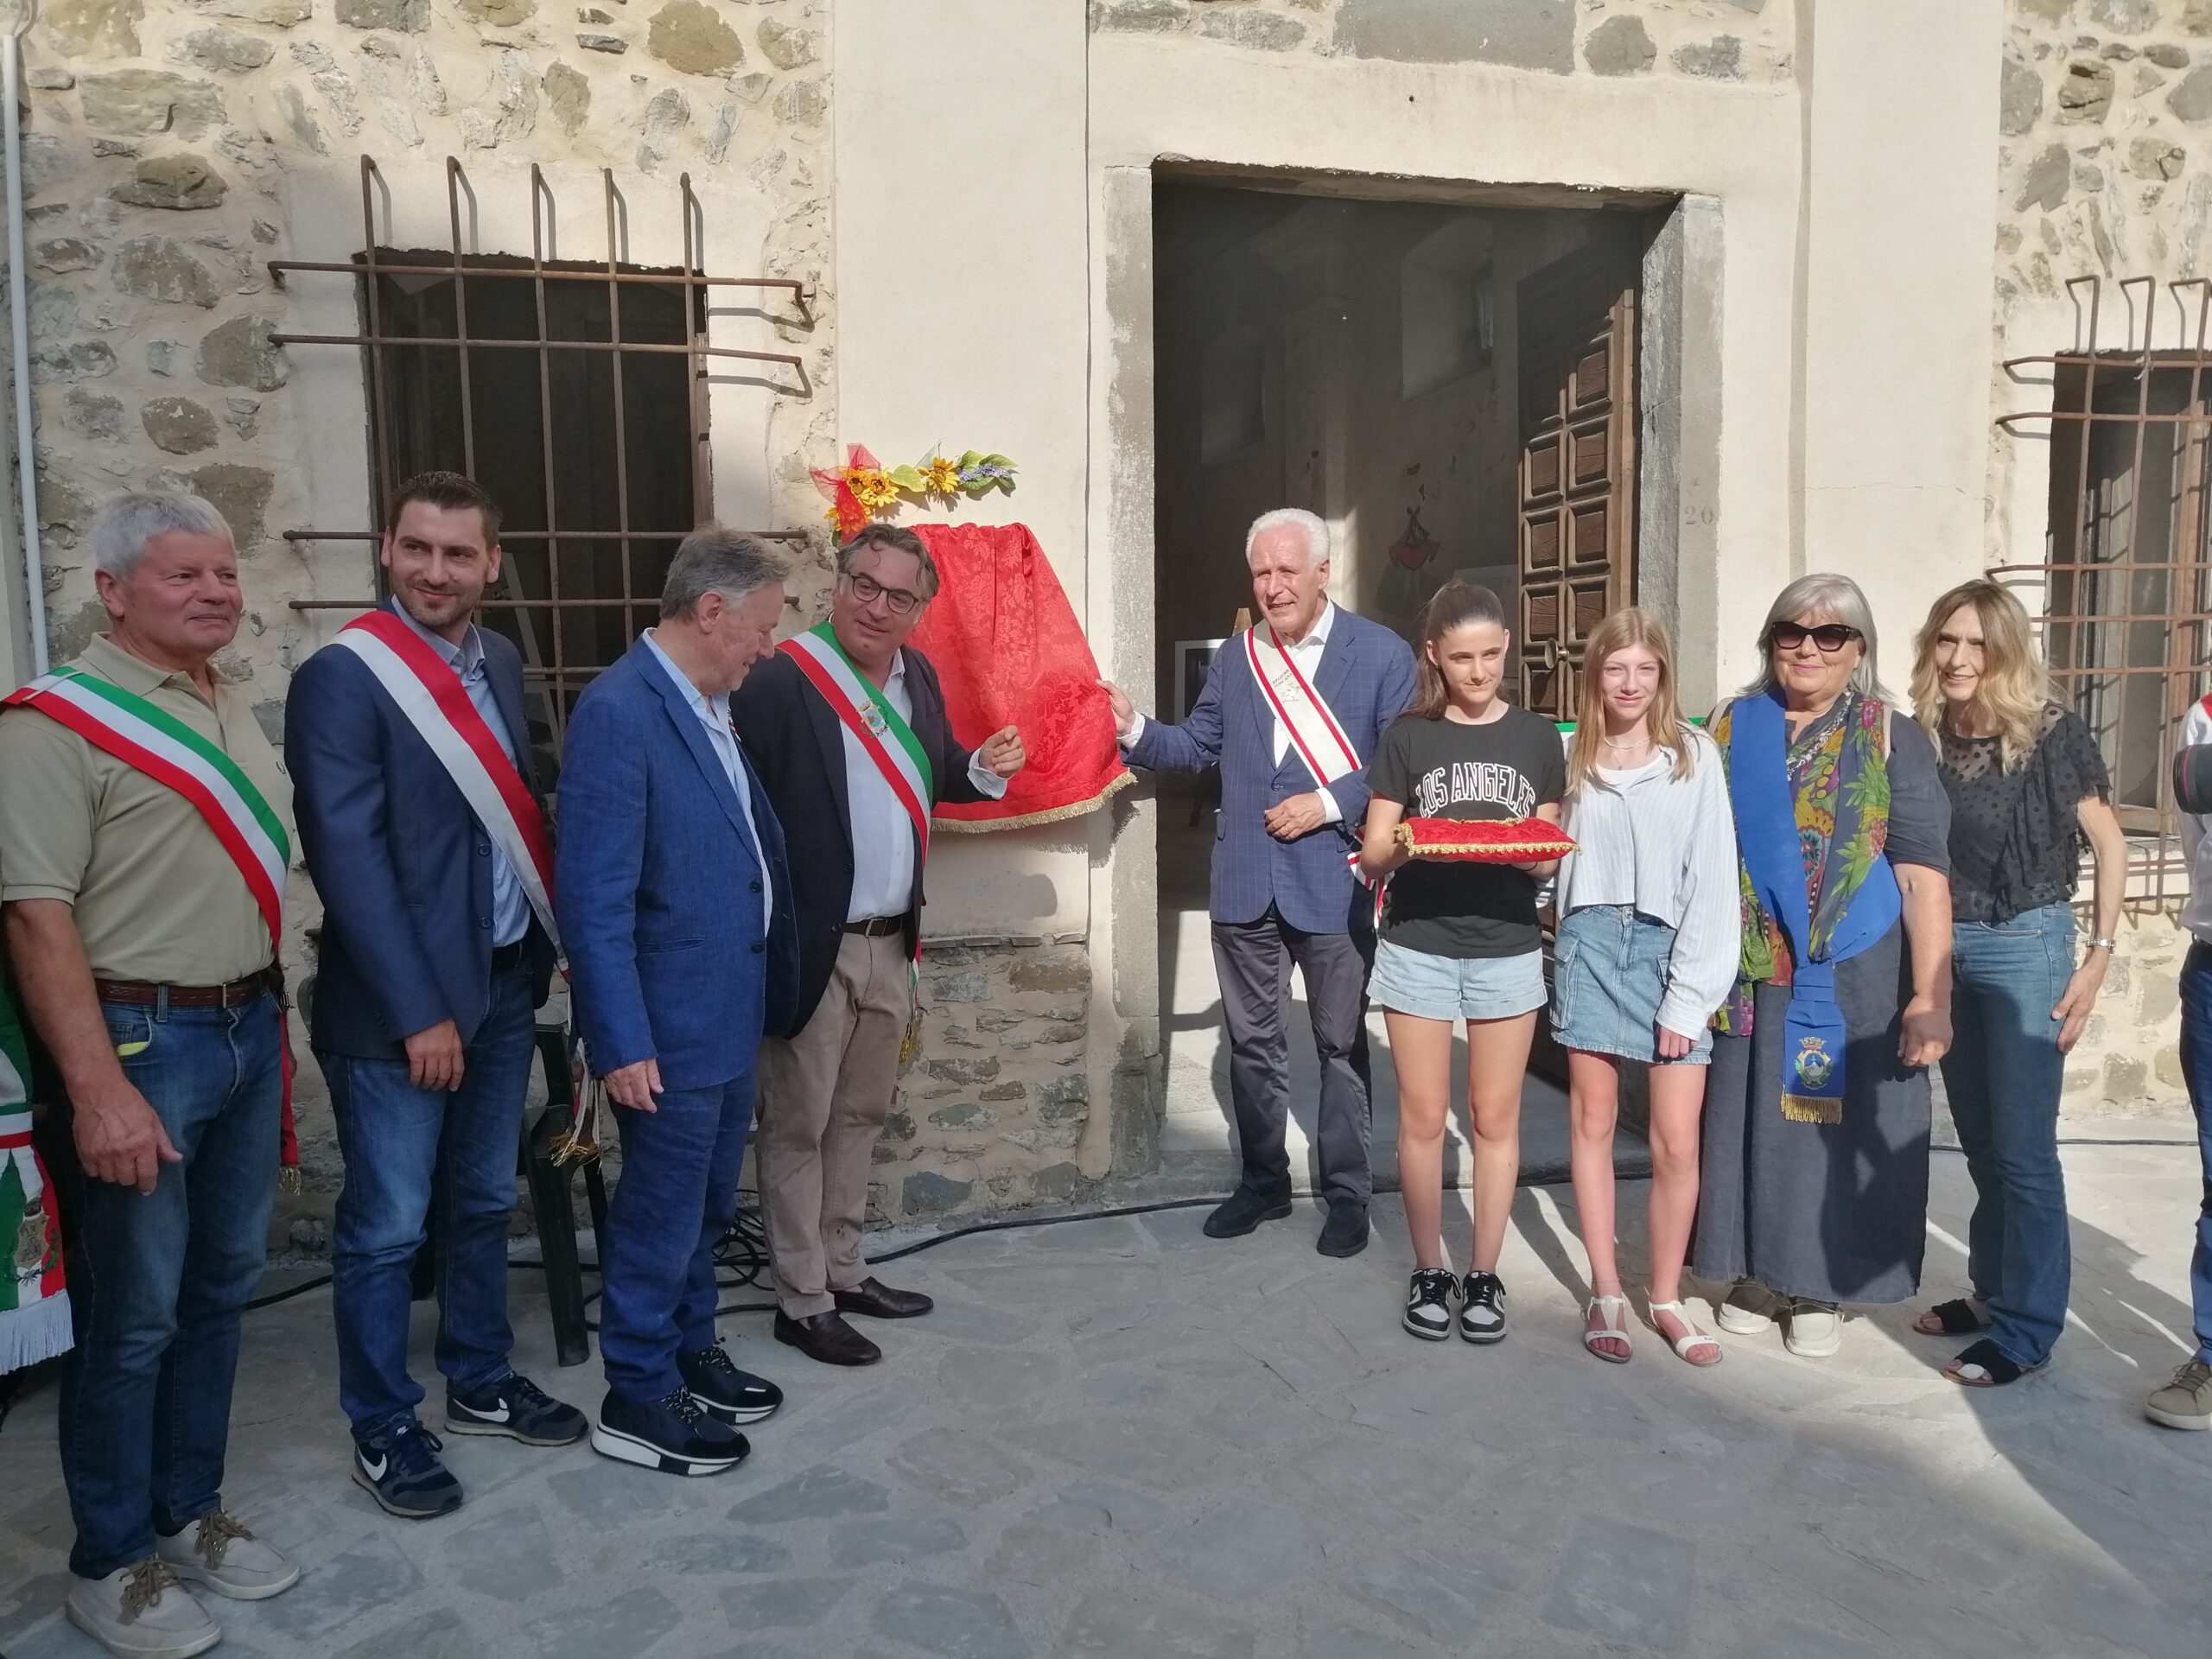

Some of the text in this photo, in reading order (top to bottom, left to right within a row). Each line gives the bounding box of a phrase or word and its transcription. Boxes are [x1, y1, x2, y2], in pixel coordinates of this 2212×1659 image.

[1685, 505, 1714, 525] 20
[1415, 762, 1535, 818] LOS ANGELES
